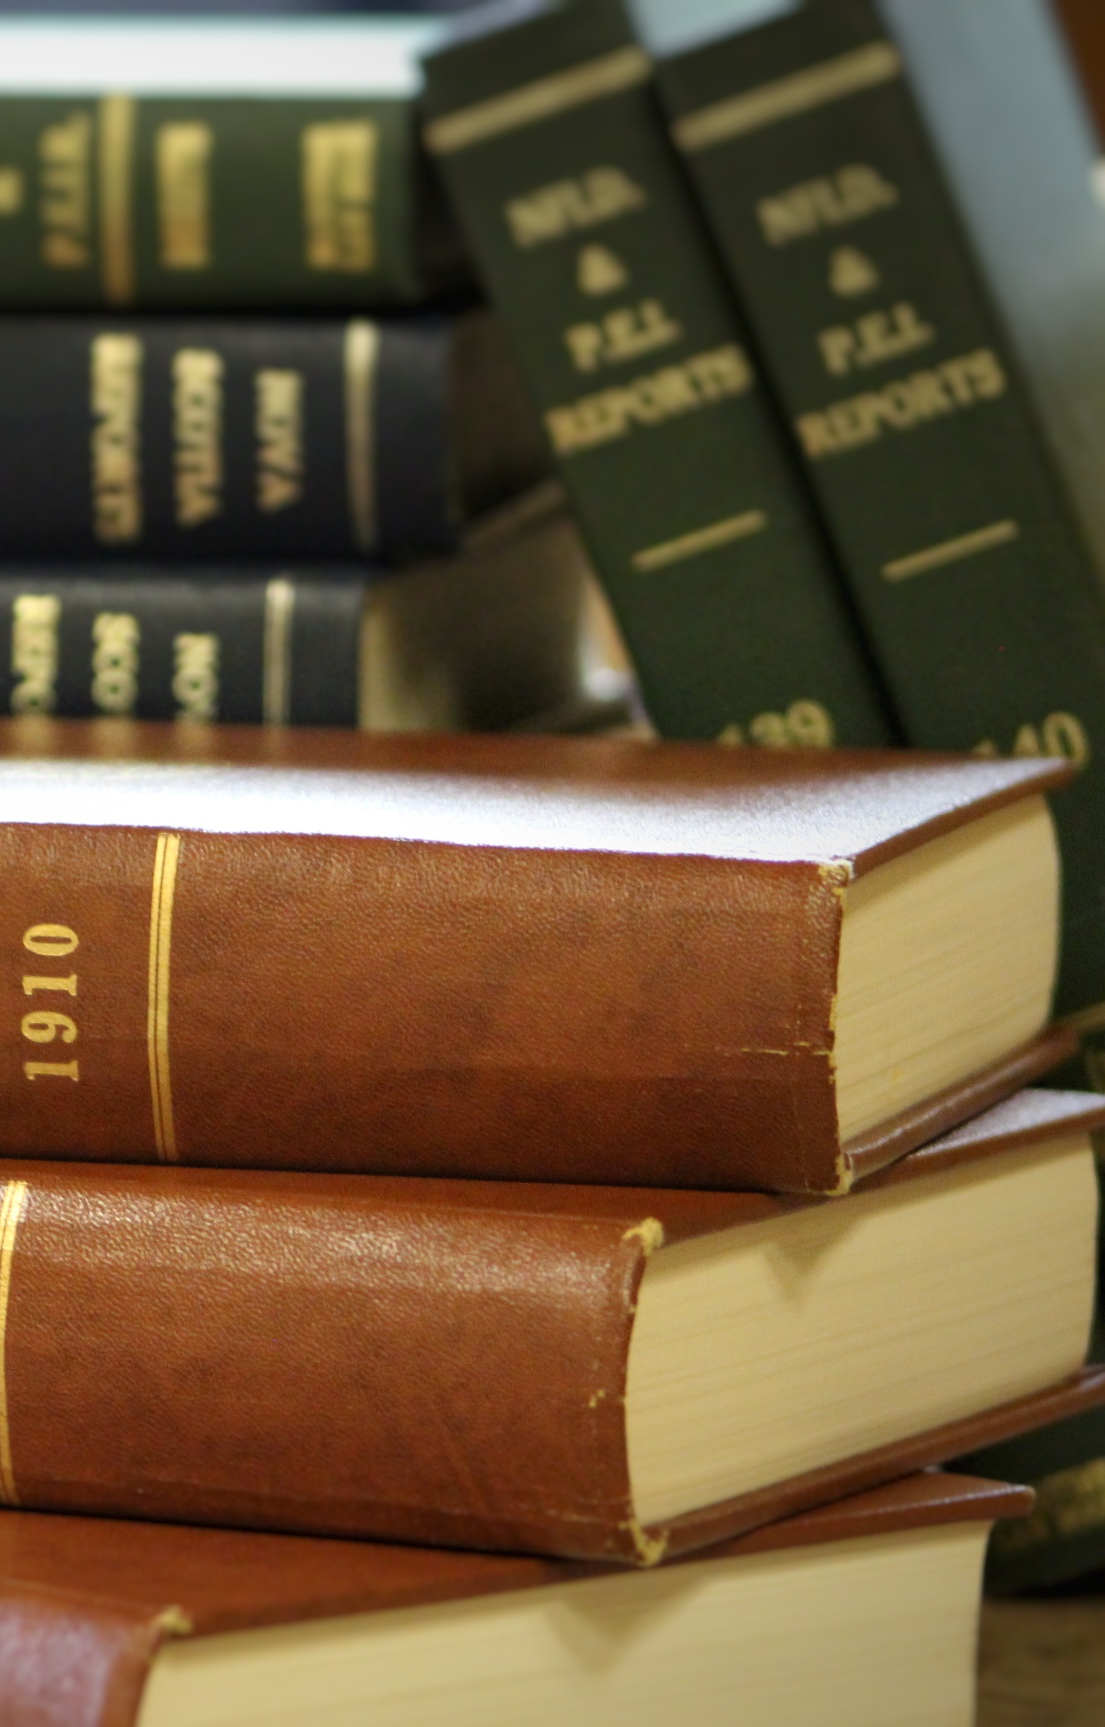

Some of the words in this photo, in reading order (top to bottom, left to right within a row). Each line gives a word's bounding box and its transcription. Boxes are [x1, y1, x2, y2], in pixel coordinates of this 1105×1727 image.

[91, 333, 142, 531] REPORTS
[173, 348, 222, 516] SCOTIA
[257, 369, 301, 504] NOVA
[546, 345, 751, 454] REPORTS
[798, 350, 1004, 458] REPORTS
[21, 923, 80, 1080] 1910
